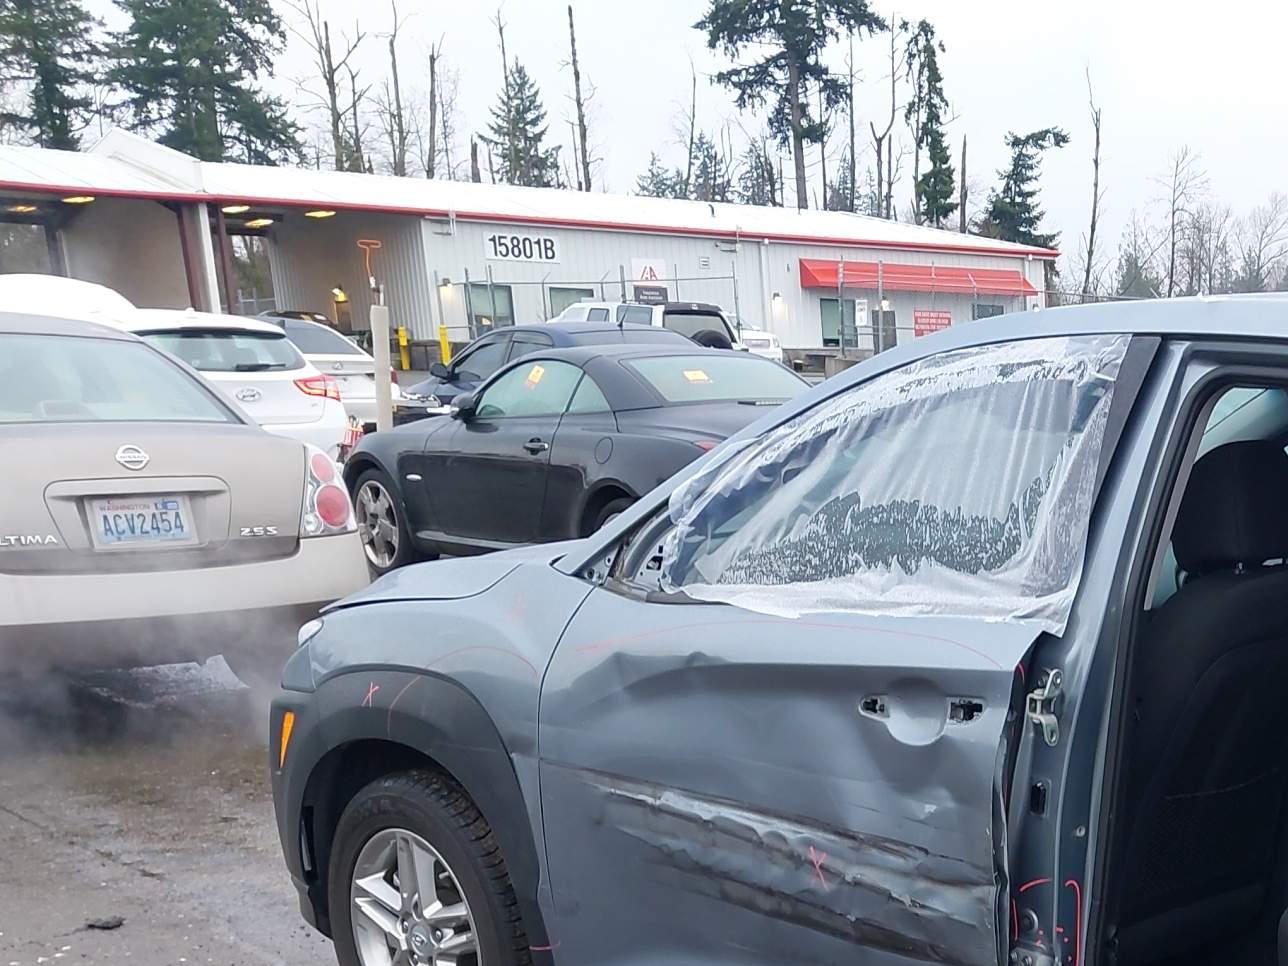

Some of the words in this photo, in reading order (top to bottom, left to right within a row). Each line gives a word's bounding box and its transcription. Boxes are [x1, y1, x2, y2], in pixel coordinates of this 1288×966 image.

[488, 234, 556, 260] 15801B
[99, 503, 152, 511] WASHINGTON
[102, 511, 185, 537] ACV2454
